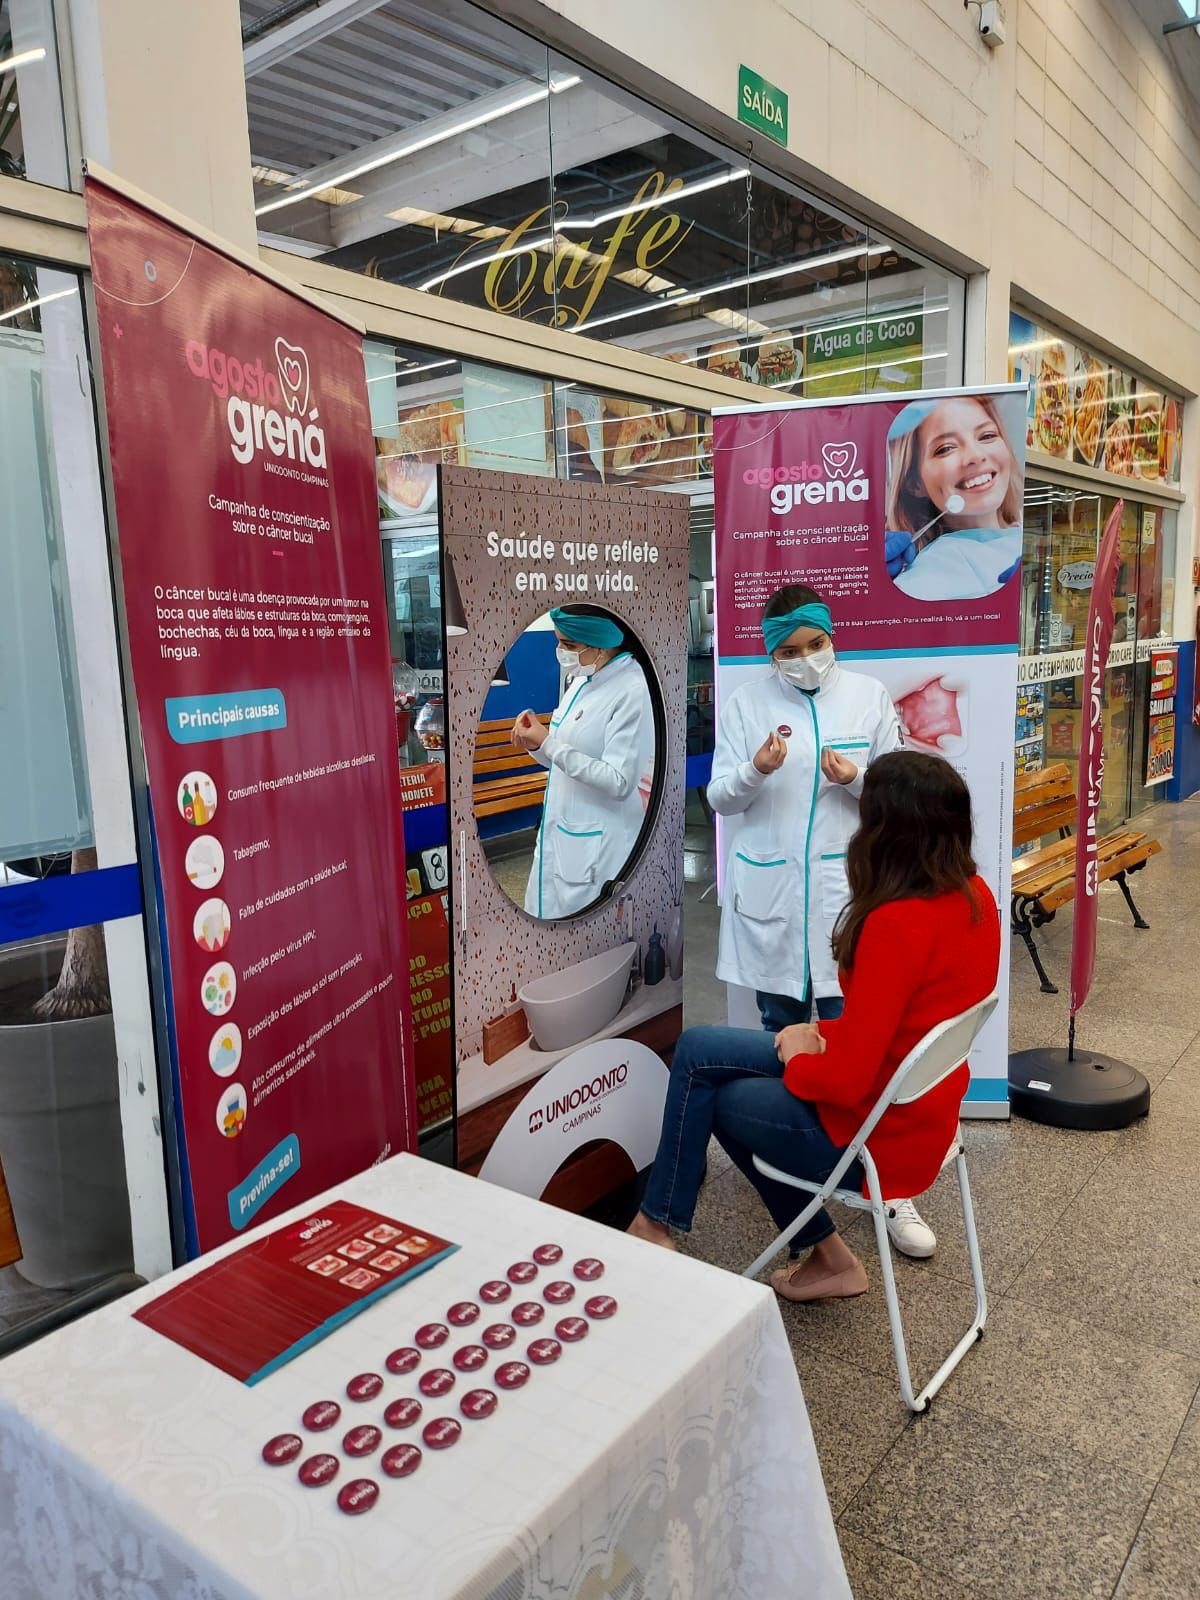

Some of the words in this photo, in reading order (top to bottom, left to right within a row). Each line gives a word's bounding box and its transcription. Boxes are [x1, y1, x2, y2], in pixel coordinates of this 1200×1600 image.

[743, 84, 784, 129] SAÍDA
[856, 326, 873, 345] de
[878, 321, 915, 341] Coco
[186, 340, 281, 405] agosto
[227, 396, 327, 469] grená
[264, 462, 300, 480] UNIODONTO
[301, 472, 329, 488] CAMPINAS
[743, 460, 823, 489] agosto
[770, 469, 869, 515] grená
[208, 494, 256, 517] Campanha
[259, 505, 270, 519] de
[271, 511, 330, 532] conscientização
[232, 519, 256, 534] sobre
[258, 526, 264, 536] o
[266, 524, 292, 540] câncer
[293, 528, 314, 544] bucal
[733, 529, 780, 541] Campanha
[783, 528, 794, 537] de
[796, 523, 869, 535] conscientização
[776, 537, 800, 546] sobre
[811, 535, 841, 544] câncer
[844, 532, 869, 542] bucal
[487, 531, 555, 560] Saúde
[562, 541, 598, 565] que
[605, 540, 658, 563] reflete
[515, 571, 547, 592] em
[554, 572, 588, 592] sua
[595, 570, 639, 592] vida.
[740, 570, 763, 579] câncer
[764, 570, 782, 578] bucal
[806, 567, 832, 576] doença
[833, 565, 869, 574] provocada
[842, 573, 863, 581] lábios
[154, 585, 164, 600] O
[165, 586, 205, 600] câncer
[207, 586, 232, 601] bucal
[232, 588, 238, 601] é
[239, 591, 255, 603] uma
[256, 590, 285, 607] doença
[286, 594, 319, 607] provocada
[320, 597, 330, 608] por
[331, 598, 343, 607] um
[343, 597, 359, 608] tumor
[360, 600, 369, 608] na
[734, 586, 768, 594] estruturas
[839, 581, 869, 589] gengiva,
[828, 589, 851, 598] língua
[156, 604, 184, 620] boca
[187, 608, 210, 622] que
[212, 605, 234, 620] afeta
[234, 607, 255, 620] lábios
[257, 610, 263, 620] e
[264, 610, 300, 621] estruturas
[301, 610, 310, 621] da
[311, 610, 327, 624] boca,
[327, 612, 346, 622] como
[734, 601, 756, 609] região
[158, 624, 222, 640] bochechas,
[224, 625, 239, 638] céu
[241, 625, 250, 638] da
[252, 625, 276, 639] boca,
[277, 625, 299, 640] língua
[301, 627, 307, 637] e
[309, 627, 314, 637] a
[316, 625, 335, 639] região
[337, 626, 360, 637] embaixo
[362, 626, 371, 637] da
[864, 618, 902, 627] prevenção.
[983, 612, 1001, 620] local
[160, 644, 201, 661] língua.
[1028, 657, 1046, 680] CAFÉ
[1046, 655, 1075, 677] EMPÓRIO
[178, 705, 244, 728] Principais
[245, 703, 280, 719] causas
[227, 784, 259, 801] Consumo
[258, 776, 294, 792] frequente
[294, 771, 303, 782] de
[303, 767, 325, 781] bebidas
[325, 760, 350, 774] alcoólicas
[233, 838, 271, 861] Tabagismo;
[239, 905, 255, 920] Falta
[255, 900, 264, 911] de
[264, 885, 295, 906] cuidados
[296, 879, 309, 891] com
[310, 877, 314, 885] a
[314, 868, 331, 883] saúde
[331, 859, 348, 874] bucal;
[242, 954, 269, 980] Infecção
[270, 945, 286, 966] pelo
[286, 938, 302, 954] vírus
[247, 1010, 280, 1040] Exposição
[280, 1001, 293, 1016] dos
[293, 988, 312, 1007] lábios
[312, 984, 319, 994] ao
[319, 974, 328, 988] sol
[327, 968, 340, 983] sem
[252, 1073, 265, 1092] Alto
[265, 1050, 296, 1080] consumo
[296, 1042, 305, 1056] de
[305, 1021, 332, 1049] alimentos
[332, 1012, 345, 1026] ultra
[345, 988, 374, 1019] processados
[374, 985, 378, 993] e
[253, 1076, 285, 1108] alimentos
[546, 1064, 628, 1123] UNIODONTO
[562, 1104, 602, 1133] CAMPINAS
[240, 1148, 294, 1215] Previna-se!
